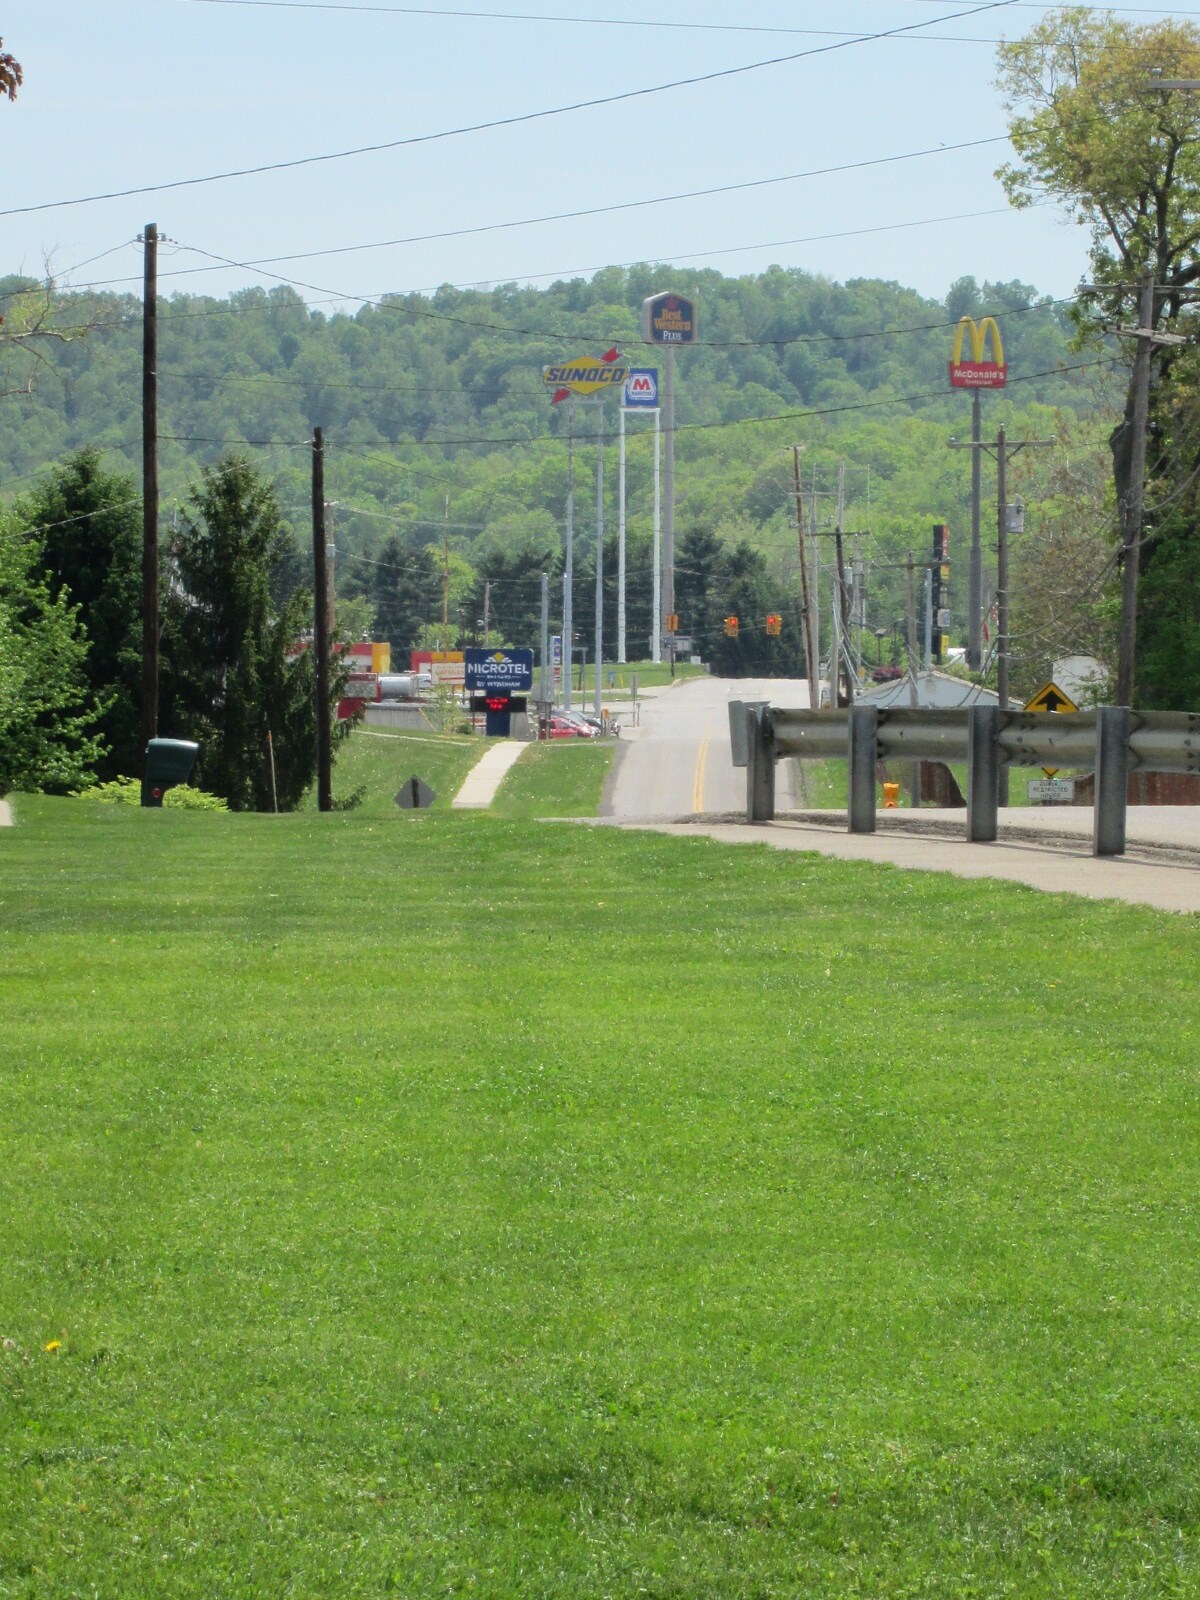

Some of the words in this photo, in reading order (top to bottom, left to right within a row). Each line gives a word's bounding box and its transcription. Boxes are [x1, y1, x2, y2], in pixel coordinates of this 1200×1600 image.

[546, 367, 625, 382] SUNOCO
[953, 370, 1004, 379] McDonald's
[467, 663, 530, 674] MICROTEL
